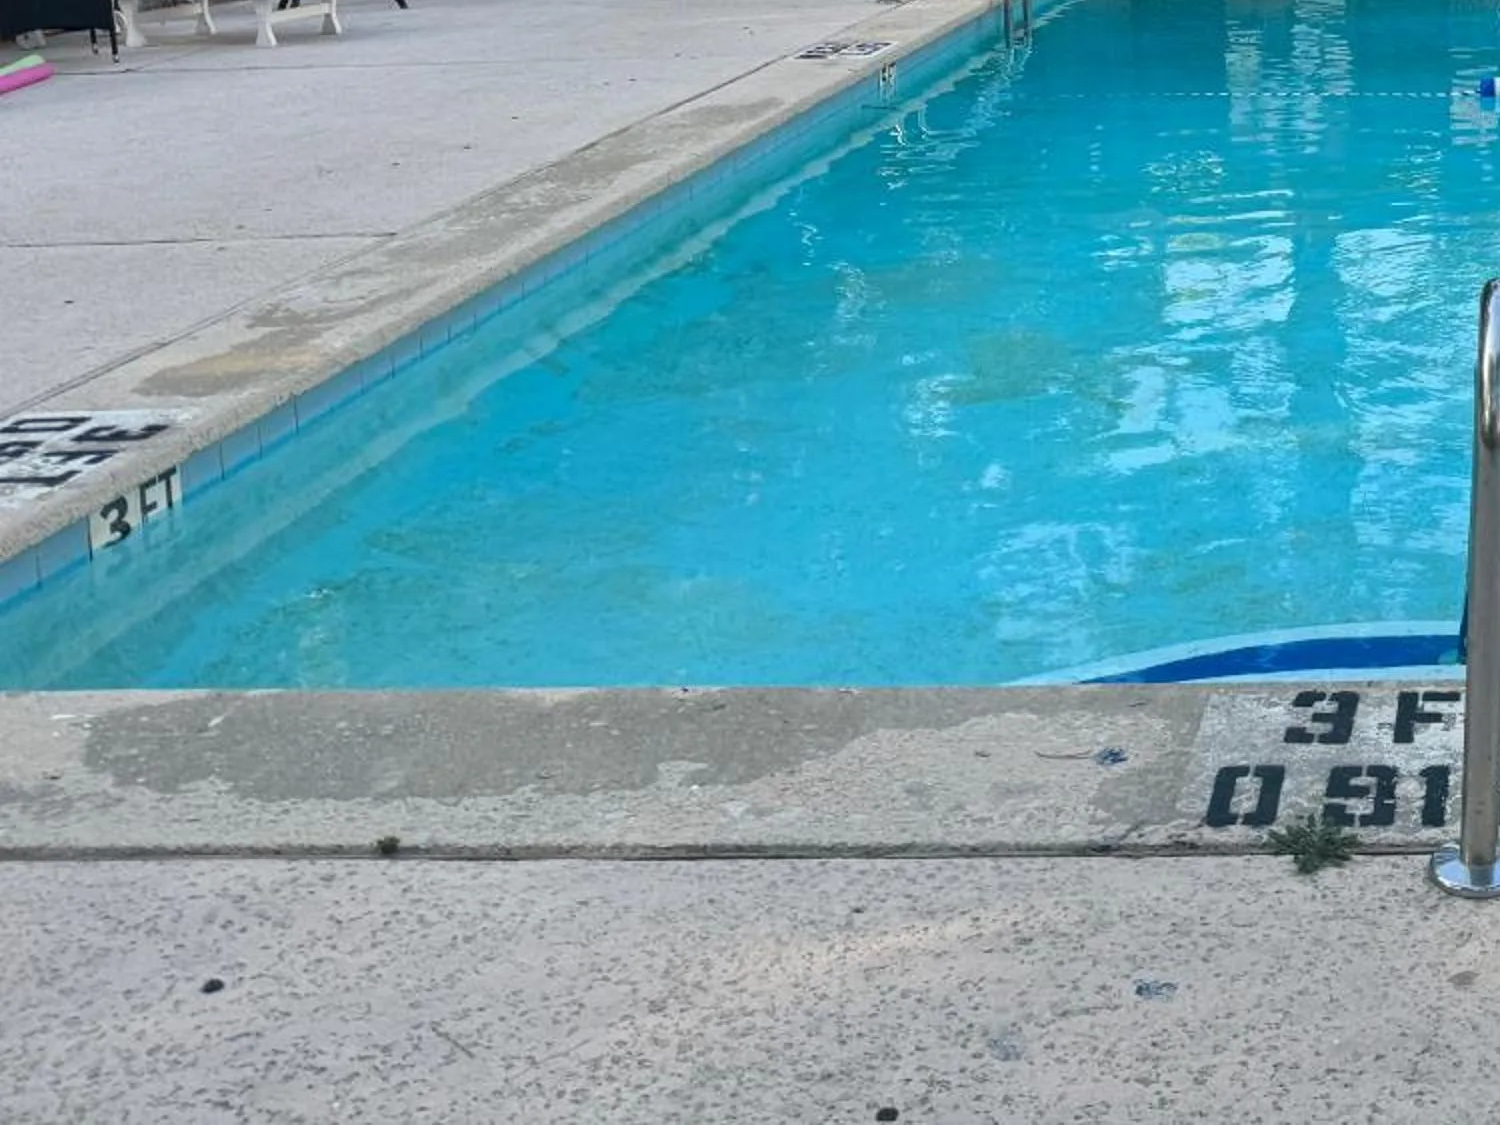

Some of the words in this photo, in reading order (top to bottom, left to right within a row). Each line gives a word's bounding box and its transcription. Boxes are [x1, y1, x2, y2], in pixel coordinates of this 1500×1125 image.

[100, 495, 132, 548] 3
[139, 466, 177, 516] FT
[1284, 690, 1360, 744] 3
